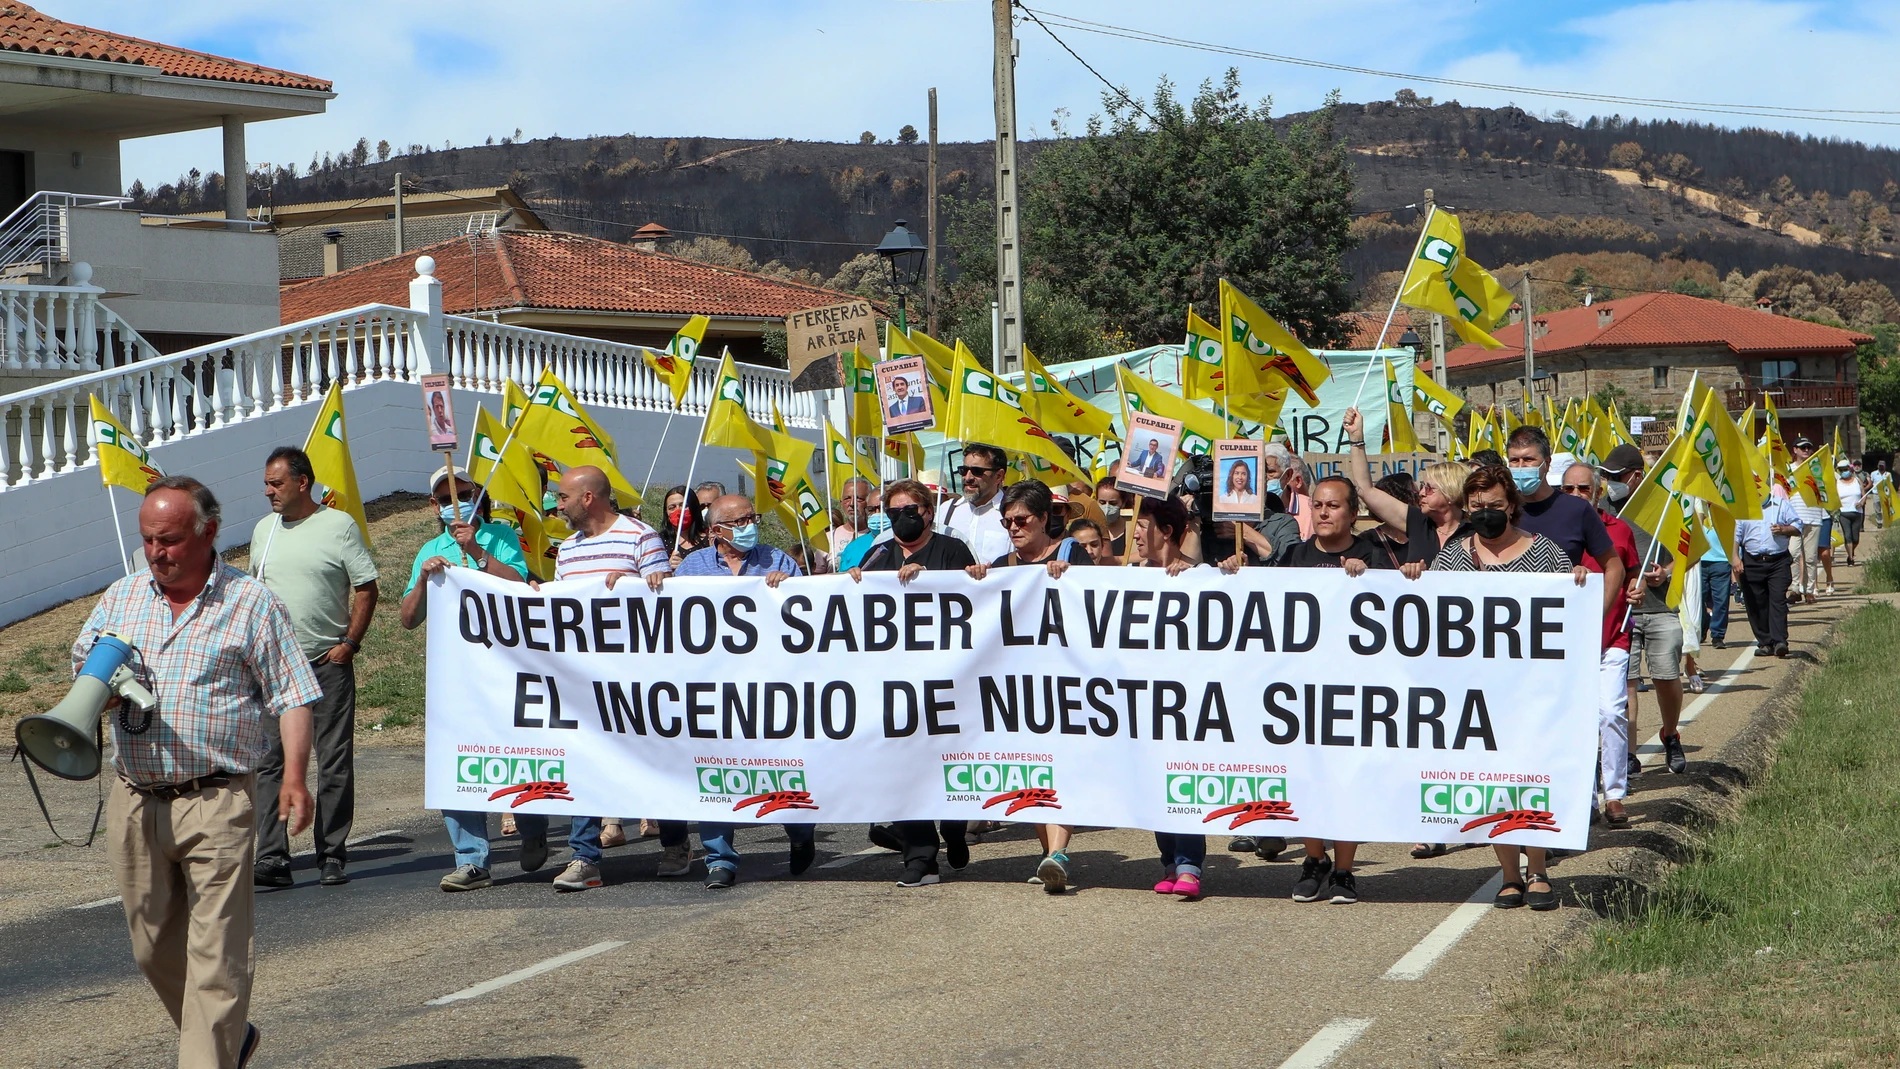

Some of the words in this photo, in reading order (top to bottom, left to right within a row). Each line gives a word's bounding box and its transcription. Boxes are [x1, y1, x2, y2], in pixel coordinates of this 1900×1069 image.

[793, 303, 868, 329] FERRERAS
[826, 322, 840, 333] DE
[807, 327, 866, 351] ARRIBA
[881, 361, 918, 373] CULPABLE
[1136, 416, 1176, 431] CULPABLE
[460, 590, 757, 654] QUEREMOS
[781, 593, 972, 653] SABER
[1001, 588, 1068, 647] LA
[1085, 590, 1320, 652] VERDAD
[1349, 593, 1564, 659] SOBRE
[514, 673, 578, 729] EL
[593, 681, 856, 740] INCENDIO
[884, 680, 960, 737] DE
[979, 675, 1234, 742] NUESTRA
[1263, 683, 1497, 750] SIERRA
[458, 743, 486, 754] UNIÓN
[489, 746, 500, 754] DE
[504, 747, 566, 757] CAMPESINOS
[942, 751, 975, 761] UNIÓN
[978, 752, 991, 760] DE
[994, 752, 1054, 763] CAMPESINOS
[694, 755, 723, 765] UNIÓN
[726, 758, 738, 766] DE
[741, 758, 804, 767] CAMPESINOS
[1166, 760, 1199, 771] UNIÓN
[1202, 763, 1215, 772] DE
[1218, 763, 1287, 774] CAMPESINOS
[457, 756, 565, 785] COAG
[943, 764, 1054, 792] COAG
[1421, 769, 1456, 780] UNIÓN
[1460, 772, 1475, 781] DE
[1478, 772, 1551, 784] CAMPESINOS
[696, 767, 807, 795] COAG
[457, 786, 488, 794] ZAMORA
[1166, 774, 1287, 805] COAG
[699, 796, 732, 804] ZAMORA
[1421, 783, 1550, 815] COAG
[1167, 806, 1202, 815] ZAMORA
[1421, 816, 1459, 825] ZAMORA
